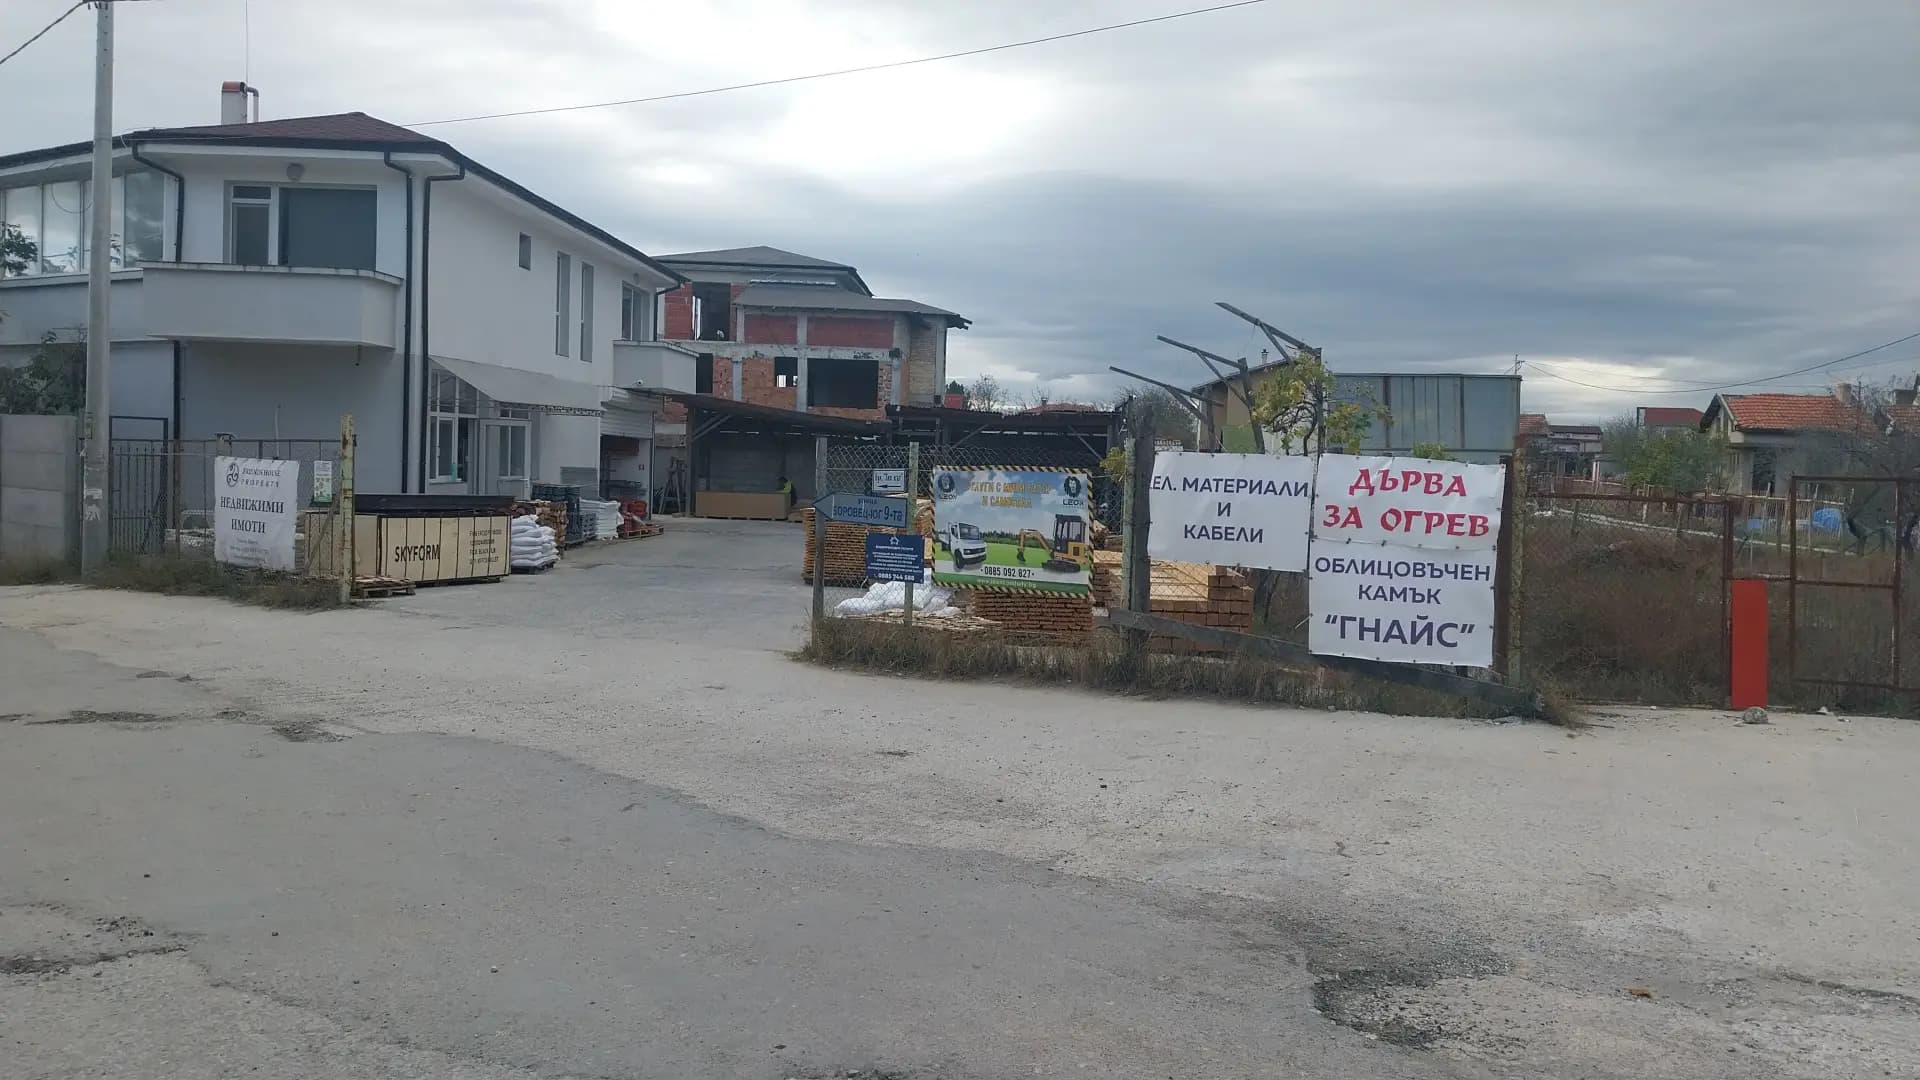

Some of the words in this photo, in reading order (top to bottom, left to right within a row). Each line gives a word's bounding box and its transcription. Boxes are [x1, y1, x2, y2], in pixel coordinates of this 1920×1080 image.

[1152, 476, 1177, 491] ЕЛ.
[1182, 477, 1309, 497] МАТЕРИАЛИ
[1349, 468, 1467, 497] ДЪРВА
[220, 496, 285, 513] НЕДВИЖИМИ
[1217, 502, 1232, 517] И
[231, 518, 266, 533] ИМОТИ
[1323, 504, 1363, 528] ЗА
[1380, 507, 1490, 537] ОГРЕВ
[1184, 524, 1264, 544] КАБЕЛИ
[394, 544, 440, 562] SKYFORM
[984, 565, 1001, 576] 0885
[1003, 566, 1016, 578] 092
[1018, 568, 1031, 579] 827
[1315, 557, 1490, 582] ОБЛИЦОВЪЧЕН
[1358, 584, 1442, 605] КАМЪК
